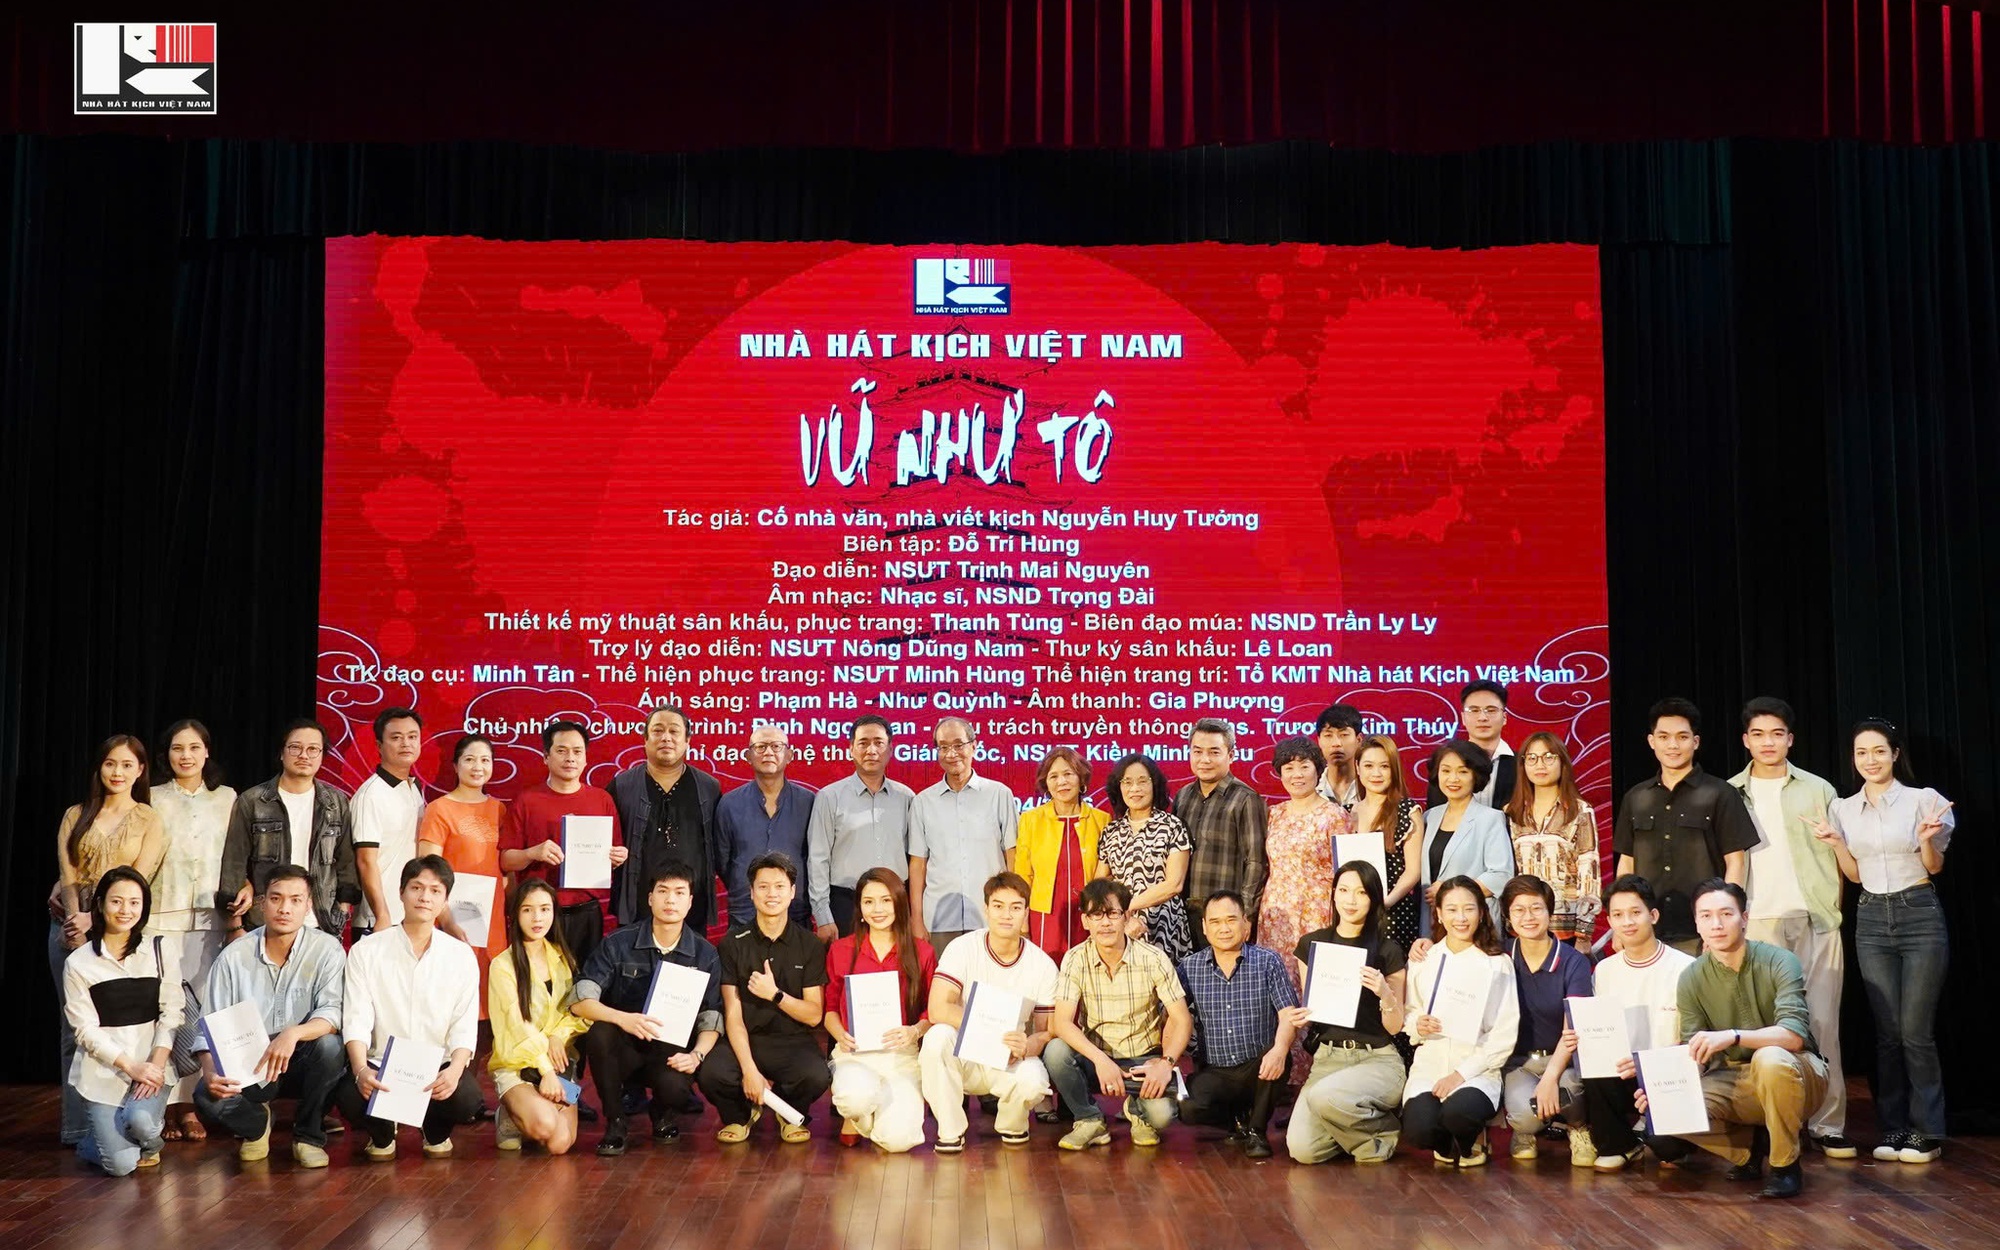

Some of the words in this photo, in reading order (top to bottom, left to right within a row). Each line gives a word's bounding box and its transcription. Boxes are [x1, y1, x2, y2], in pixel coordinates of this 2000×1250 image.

[970, 306, 988, 314] VIỆT
[741, 329, 810, 358] NHÀ
[828, 329, 896, 358] HÁT
[911, 334, 990, 362] KỊCH
[1005, 329, 1086, 363] VIỆT
[1101, 334, 1182, 358] NAM
[800, 377, 876, 487] VŨ
[896, 389, 1024, 486] NHƯ
[1037, 389, 1115, 484] TÔ
[663, 508, 702, 526] Tác
[710, 509, 750, 530] giả:
[757, 506, 788, 526] Cố
[795, 509, 835, 526] nhà
[842, 509, 887, 530] văn,
[896, 509, 936, 526] nhà
[943, 506, 983, 527] viết
[990, 509, 1034, 530] kịch
[1043, 505, 1127, 531] Nguyễn
[1134, 510, 1178, 531] Huy
[1183, 509, 1259, 531] Tưởng
[844, 535, 892, 552] Biên
[900, 535, 941, 556] tập:
[948, 532, 979, 552] Đỗ
[986, 535, 1014, 552] Trí
[1021, 535, 1079, 557] Hùng
[772, 561, 816, 582] Đạo
[823, 558, 877, 578] diễn:
[885, 561, 951, 578] NSƯT
[957, 561, 1013, 582] Trịnh
[1021, 561, 1058, 578] Mai
[1066, 561, 1150, 583] Nguyên
[767, 583, 805, 604] Âm
[812, 587, 872, 608] nhạc:
[881, 587, 936, 608] Nhạc
[943, 587, 969, 608] sĩ,
[976, 587, 1042, 605] NSND
[1048, 587, 1112, 609] Trọng
[1118, 587, 1155, 605] Đài
[485, 609, 540, 631] Thiết
[548, 609, 573, 631] kế
[580, 613, 613, 635] mỹ
[619, 613, 676, 634] thuật
[683, 613, 722, 631] sân
[730, 609, 789, 634] khấu,
[796, 613, 851, 634] phục
[858, 614, 923, 635] trang:
[931, 613, 1000, 631] Thanh
[1007, 613, 1063, 635] Tùng
[1085, 613, 1133, 631] Biên
[1141, 613, 1181, 635] đạo
[1189, 613, 1243, 631] múa:
[1251, 613, 1317, 631] NSND
[1323, 610, 1370, 631] Trần
[1379, 613, 1405, 635] Ly
[1412, 613, 1438, 635] Ly
[589, 639, 628, 660] Trợ
[636, 639, 653, 661] lý
[660, 639, 700, 660] đạo
[709, 636, 762, 657] diễn:
[770, 639, 836, 657] NSƯT
[844, 639, 901, 661] Nông
[909, 639, 968, 661] Dũng
[975, 639, 1024, 657] Nam
[1045, 639, 1091, 657] Thư
[1098, 639, 1123, 661] ký
[1130, 639, 1168, 657] sân
[1177, 636, 1236, 657] khấu:
[1244, 639, 1270, 657] Lê
[1278, 639, 1333, 657] Loan
[346, 665, 377, 683] TK
[383, 665, 424, 686] đạo
[432, 669, 465, 686] cụ:
[473, 665, 526, 683] Minh
[533, 665, 575, 683] Tân
[596, 661, 637, 683] Thể
[645, 665, 690, 687] hiện
[699, 665, 754, 687] phục
[761, 666, 826, 687] trang:
[834, 665, 899, 684] NSƯT
[906, 665, 960, 683] Minh
[967, 665, 1025, 687] Hùng
[1032, 661, 1073, 683] Thể
[1081, 665, 1126, 687] hiện
[1134, 666, 1191, 687] trang
[1199, 665, 1229, 683] trí:
[1236, 661, 1265, 684] Tổ
[1272, 665, 1321, 684] KMT
[1328, 665, 1371, 684] Nhà
[1379, 665, 1413, 684] hát
[1420, 665, 1469, 687] Kịch
[1475, 665, 1519, 688] Việt
[1525, 665, 1575, 683] Nam
[637, 687, 683, 710] Ánh
[690, 692, 750, 713] sáng:
[759, 692, 821, 713] Phạm
[829, 692, 857, 710] Hà
[880, 692, 928, 710] Như
[933, 692, 1007, 714] Quỳnh
[1027, 688, 1064, 709] Âm
[1071, 692, 1141, 709] thanh:
[1149, 692, 1187, 710] Gia
[1194, 692, 1285, 713] Phượng
[463, 716, 508, 736] Chủ
[515, 717, 583, 735] nhi
[811, 718, 851, 739] Ngọ
[988, 717, 1044, 736] trách
[1051, 715, 1122, 739] truyền
[1402, 717, 1459, 740] Thúy
